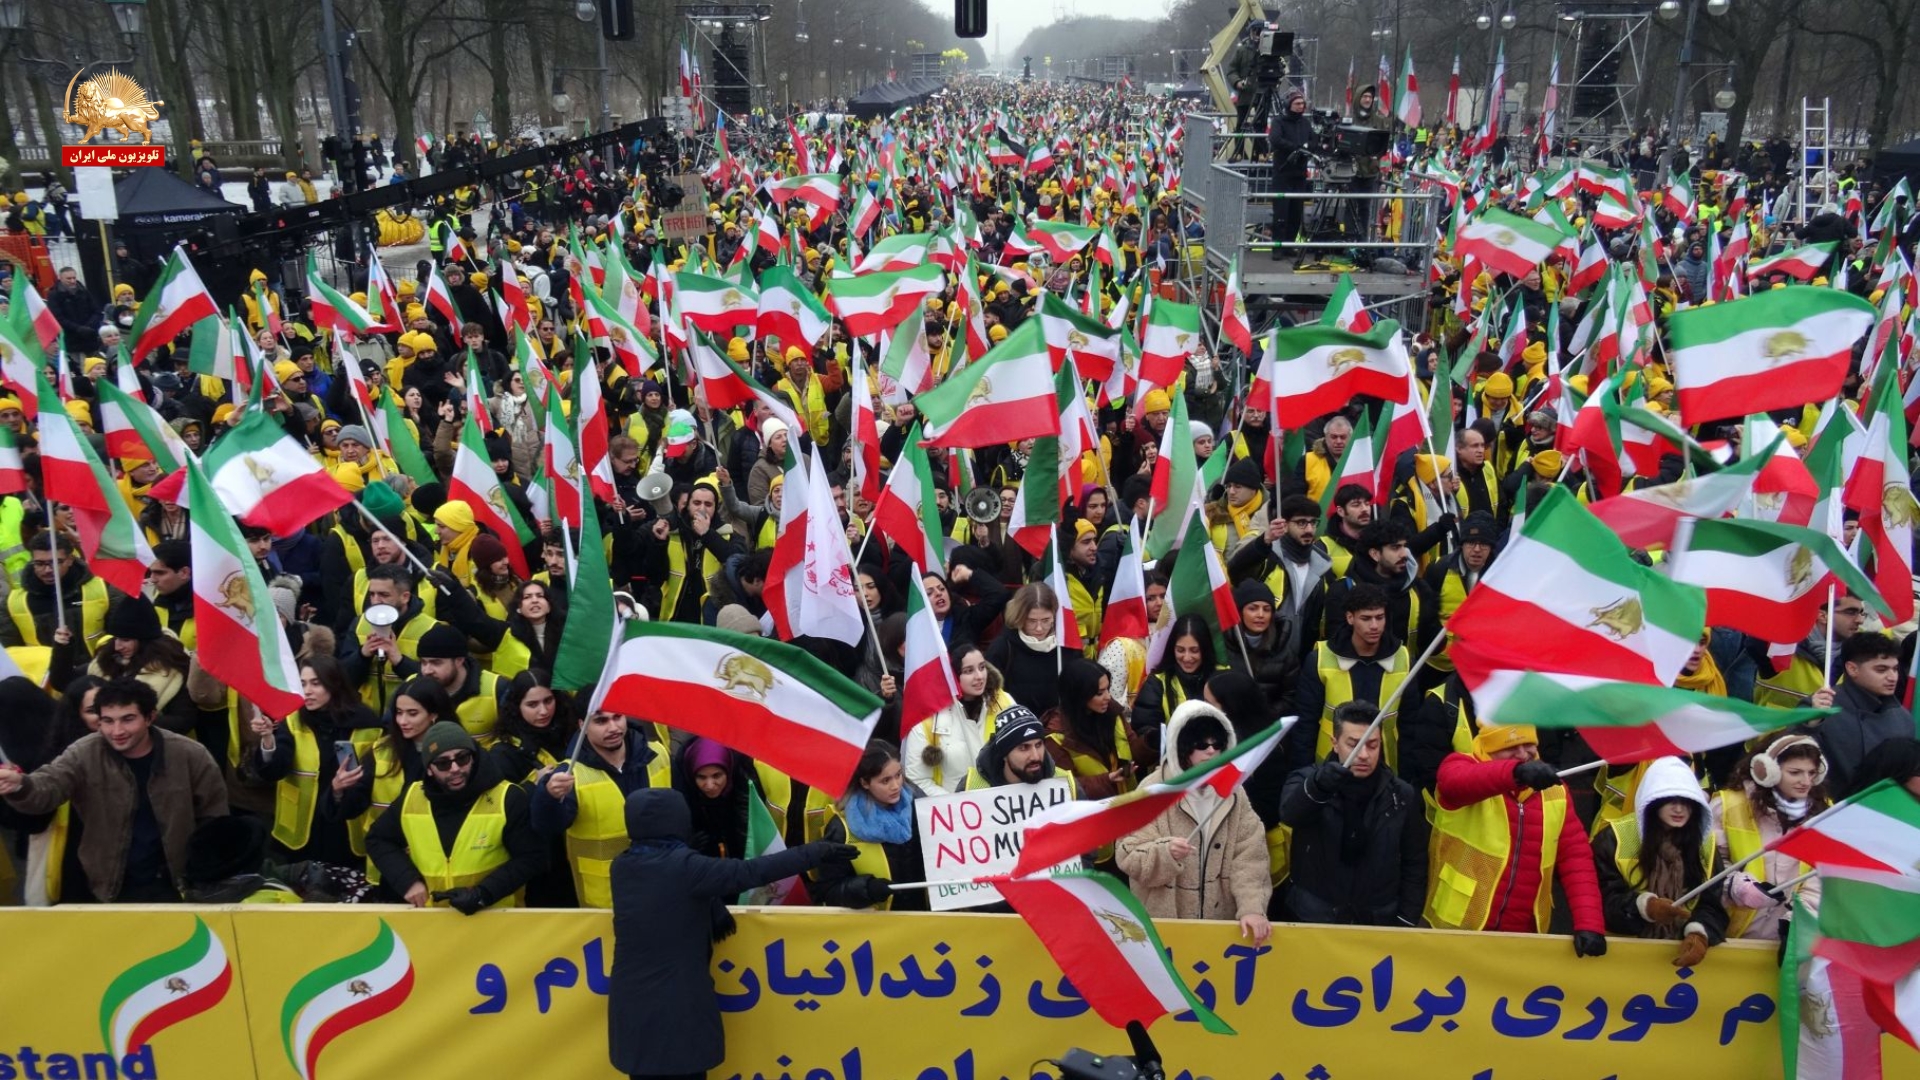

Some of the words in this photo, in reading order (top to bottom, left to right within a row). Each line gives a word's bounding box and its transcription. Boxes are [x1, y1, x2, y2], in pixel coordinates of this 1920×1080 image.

[930, 801, 983, 836] NO
[936, 835, 991, 869] NO
[468, 963, 508, 1015] و
[714, 938, 1001, 1016] زندانیان
[1291, 954, 1467, 1033] برای
[1491, 966, 1699, 1042] فوری
